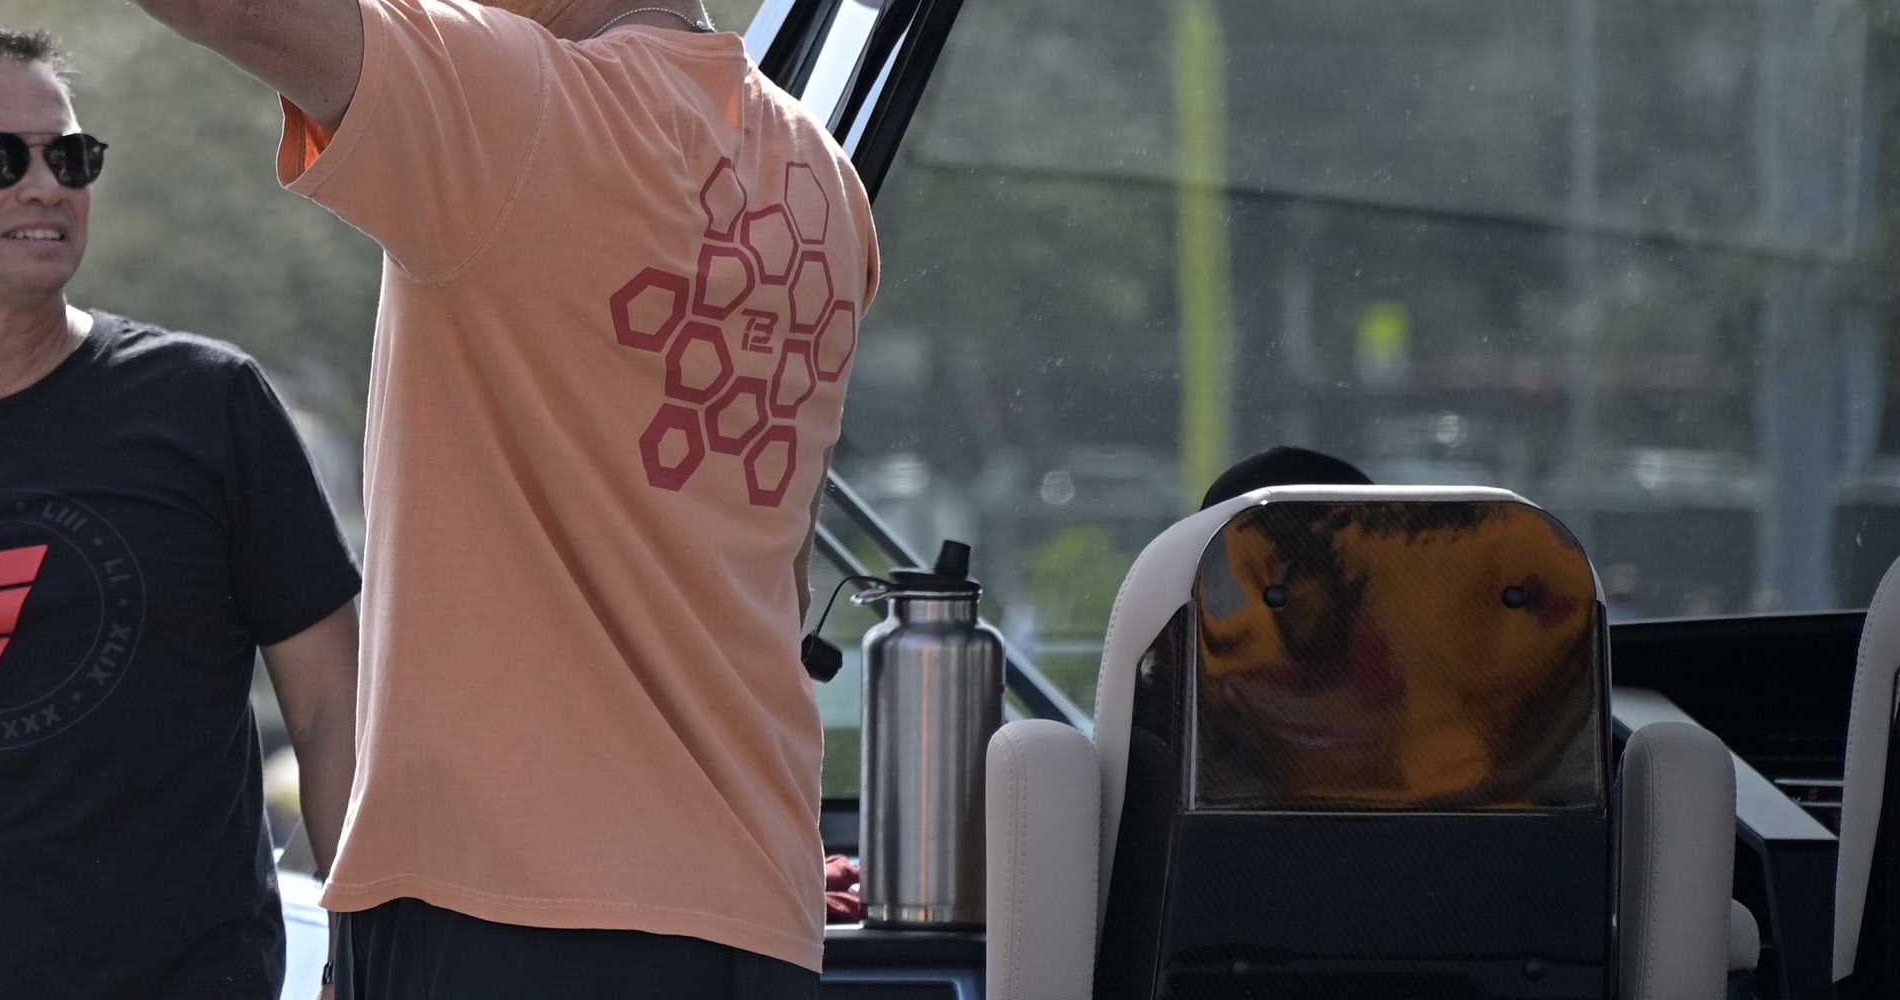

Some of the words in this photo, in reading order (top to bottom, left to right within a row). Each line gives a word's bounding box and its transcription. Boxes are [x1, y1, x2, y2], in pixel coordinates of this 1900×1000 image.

[41, 500, 88, 533] LIII
[103, 556, 131, 583] LI
[86, 622, 132, 686] XLIX
